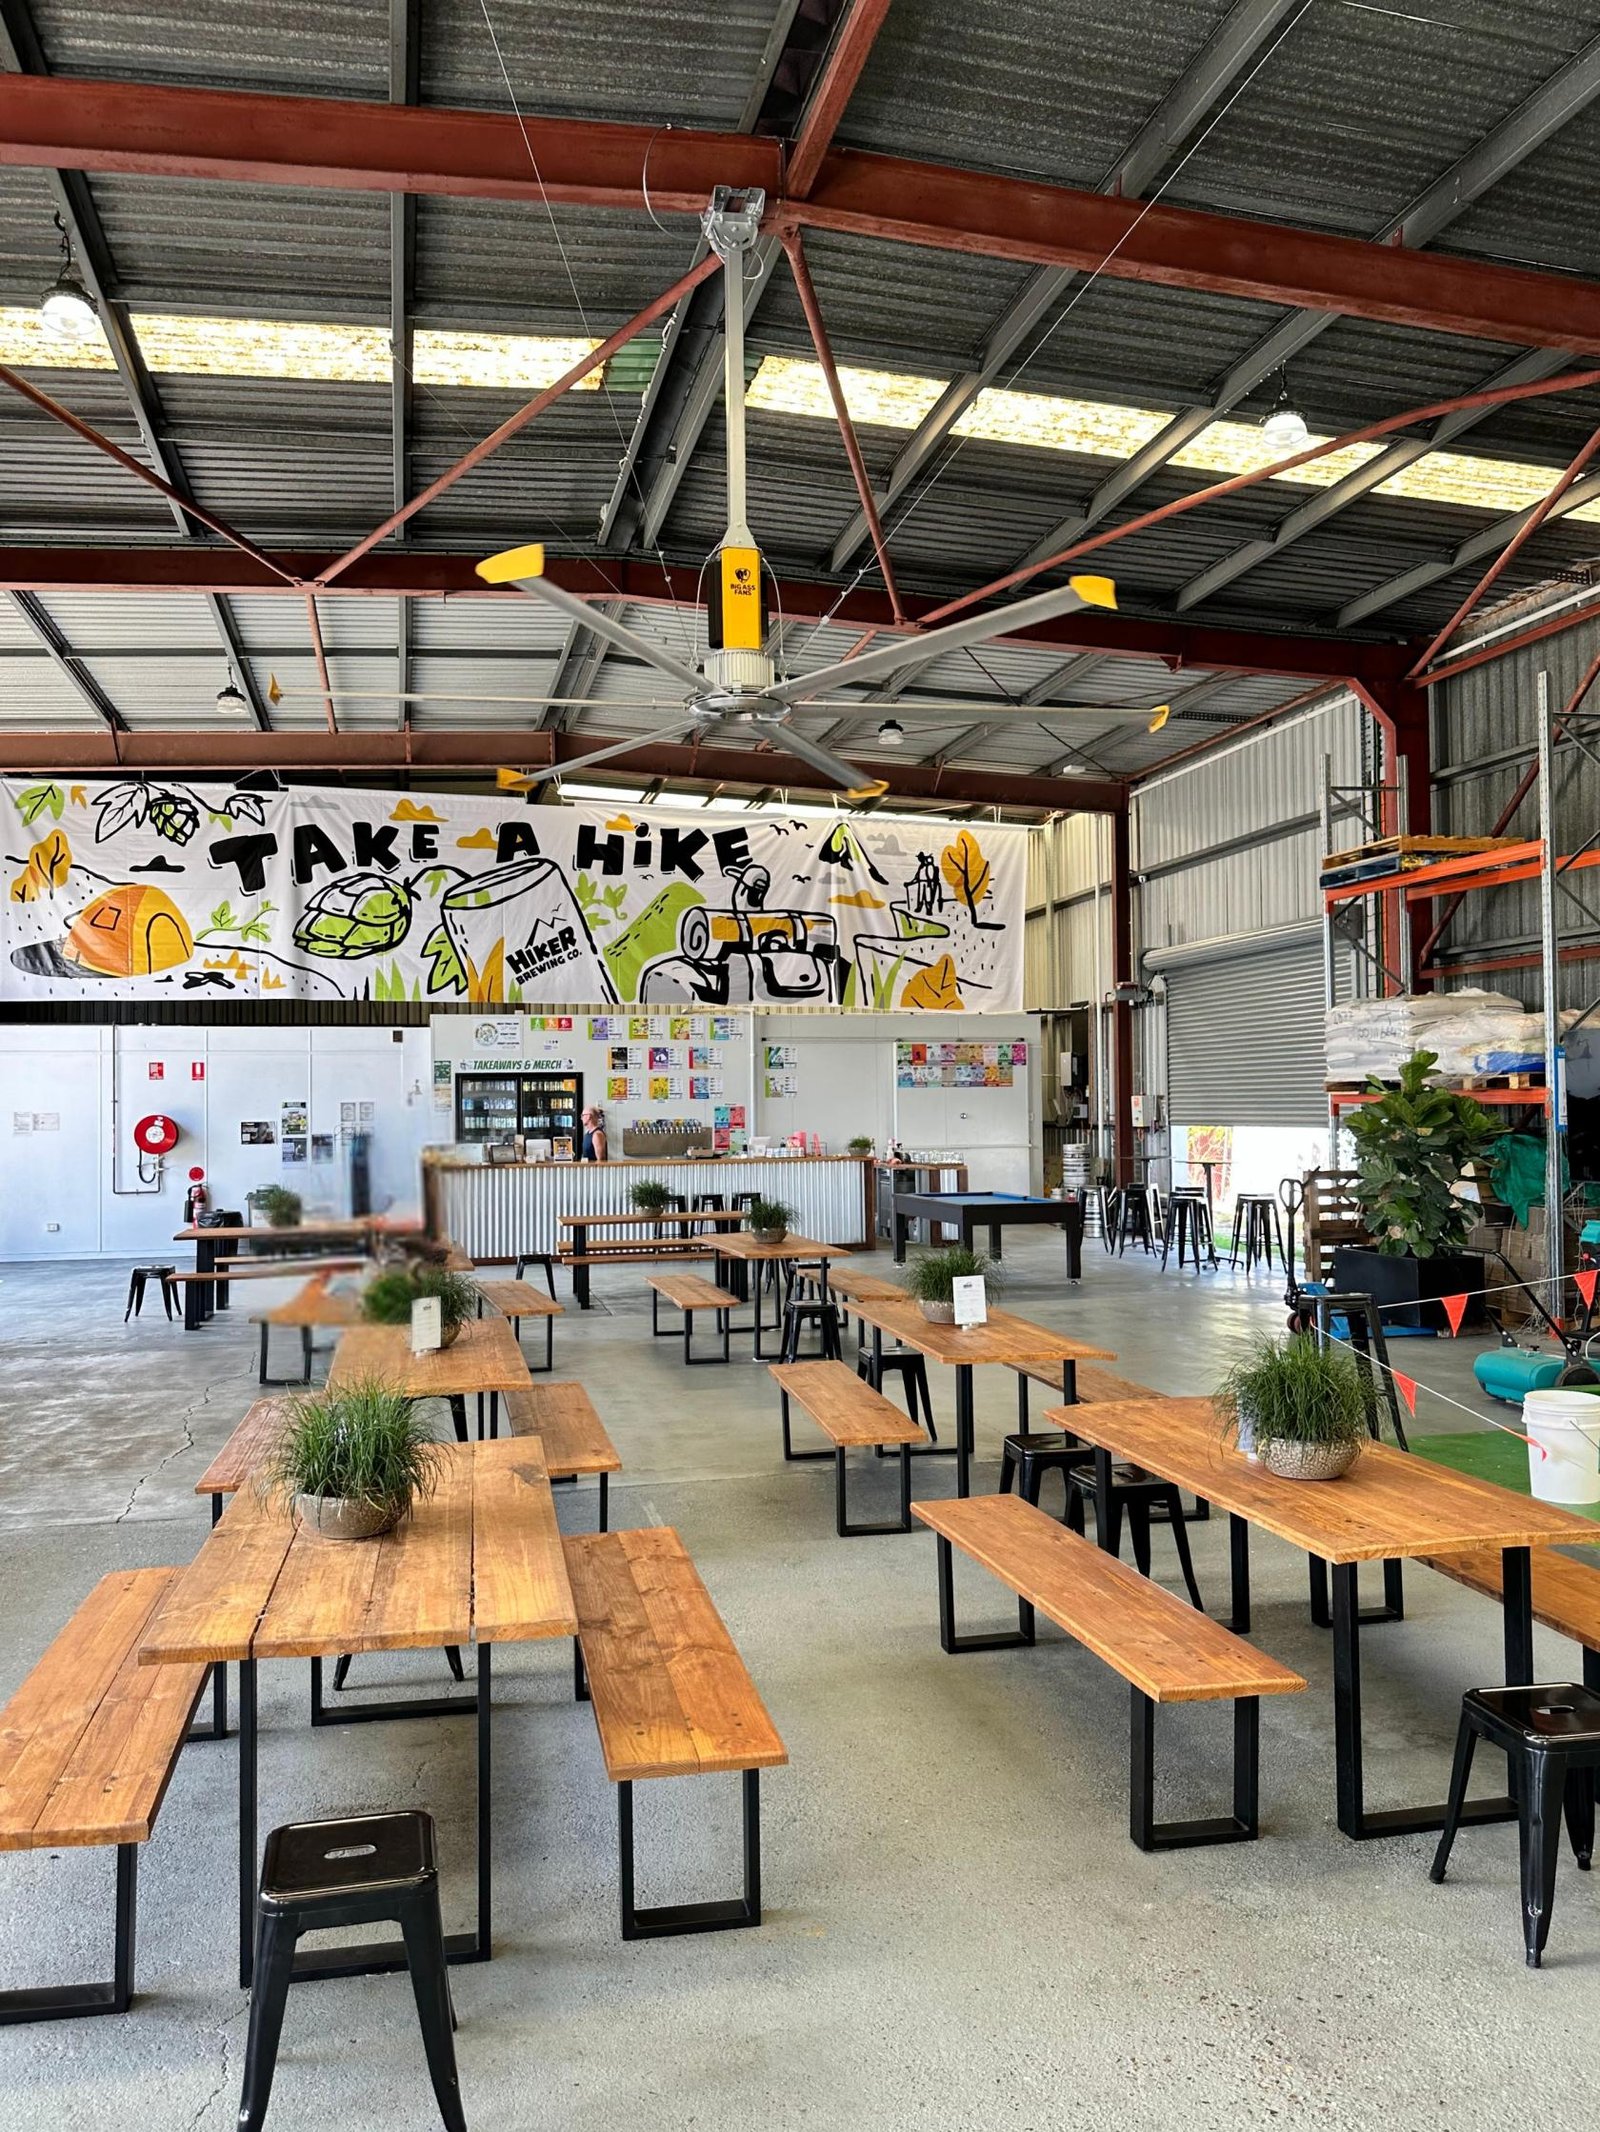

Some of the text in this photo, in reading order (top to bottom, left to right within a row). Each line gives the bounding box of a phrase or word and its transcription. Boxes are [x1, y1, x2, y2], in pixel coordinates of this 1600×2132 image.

[209, 821, 440, 892] TAKE
[496, 821, 541, 864] A
[515, 948, 583, 986] BREWING CO.
[473, 1059, 562, 1070] TAKEAWAYS & MERCH
